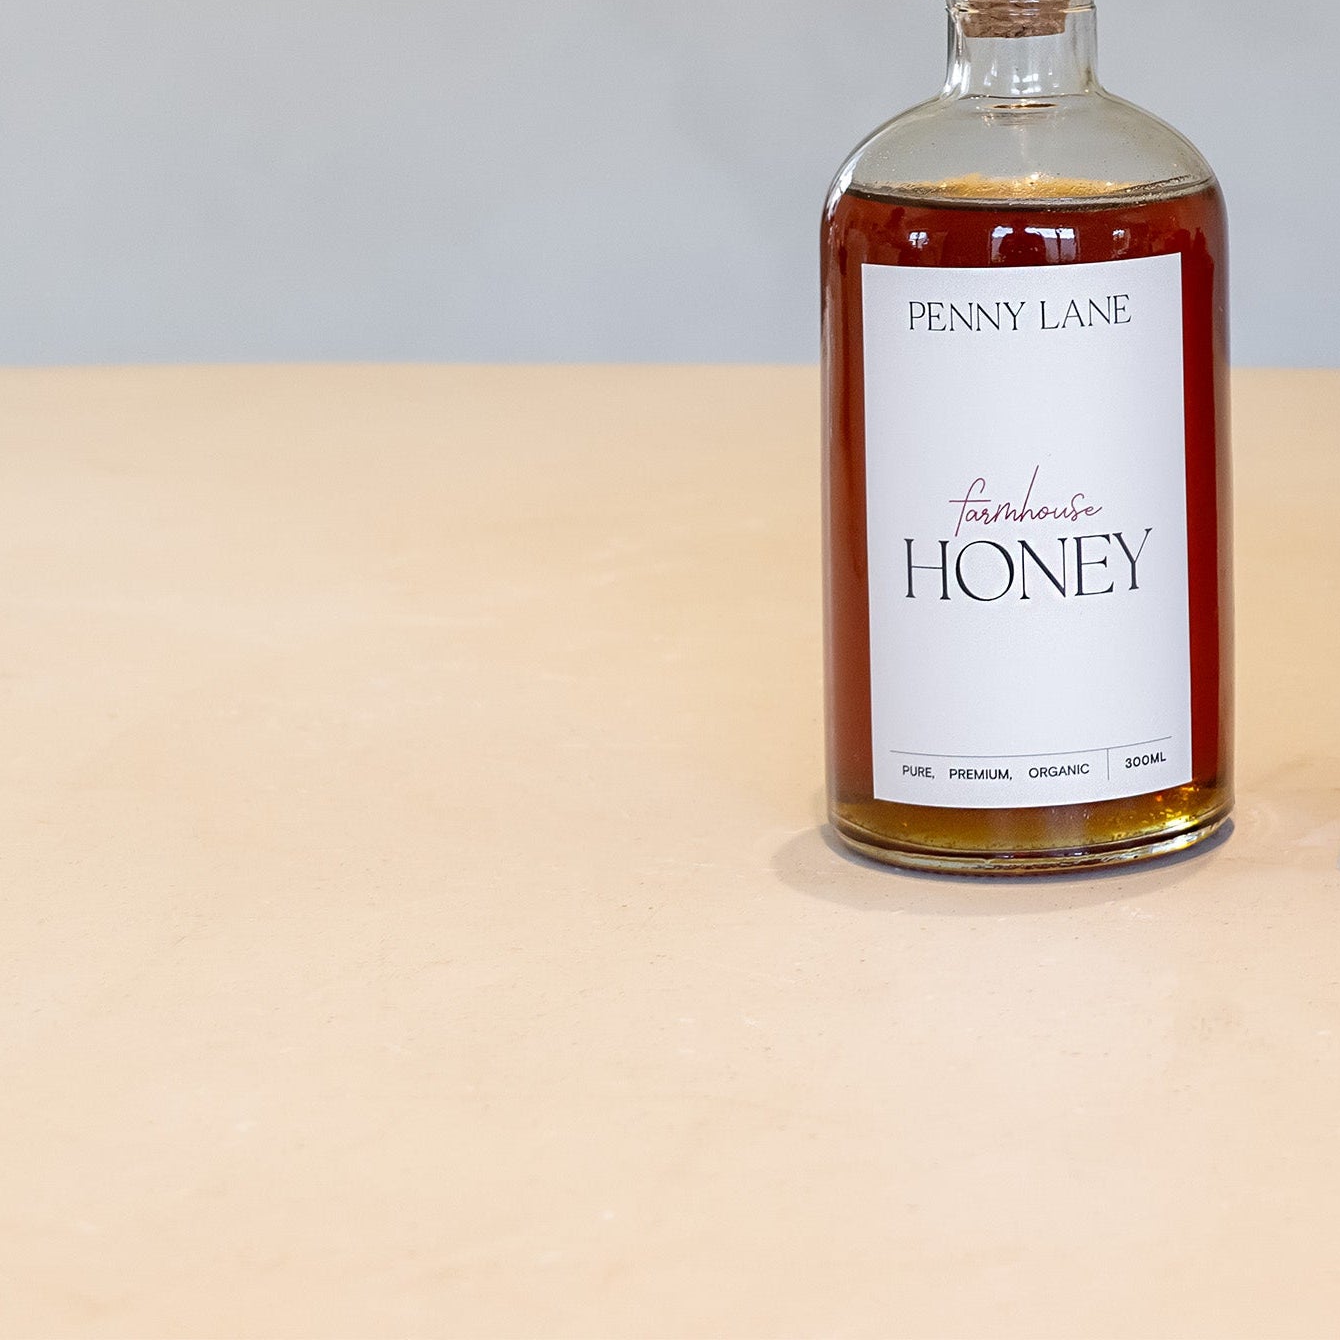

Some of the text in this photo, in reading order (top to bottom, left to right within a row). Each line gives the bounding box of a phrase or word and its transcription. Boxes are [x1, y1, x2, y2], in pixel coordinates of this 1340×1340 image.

[908, 294, 1132, 332] PENNY LANE
[948, 464, 1103, 537] farmhouse
[903, 527, 1153, 602] HONEY
[902, 762, 1090, 781] PURE, PREMIUM, ORGANIC
[1125, 751, 1167, 769] 300ML
